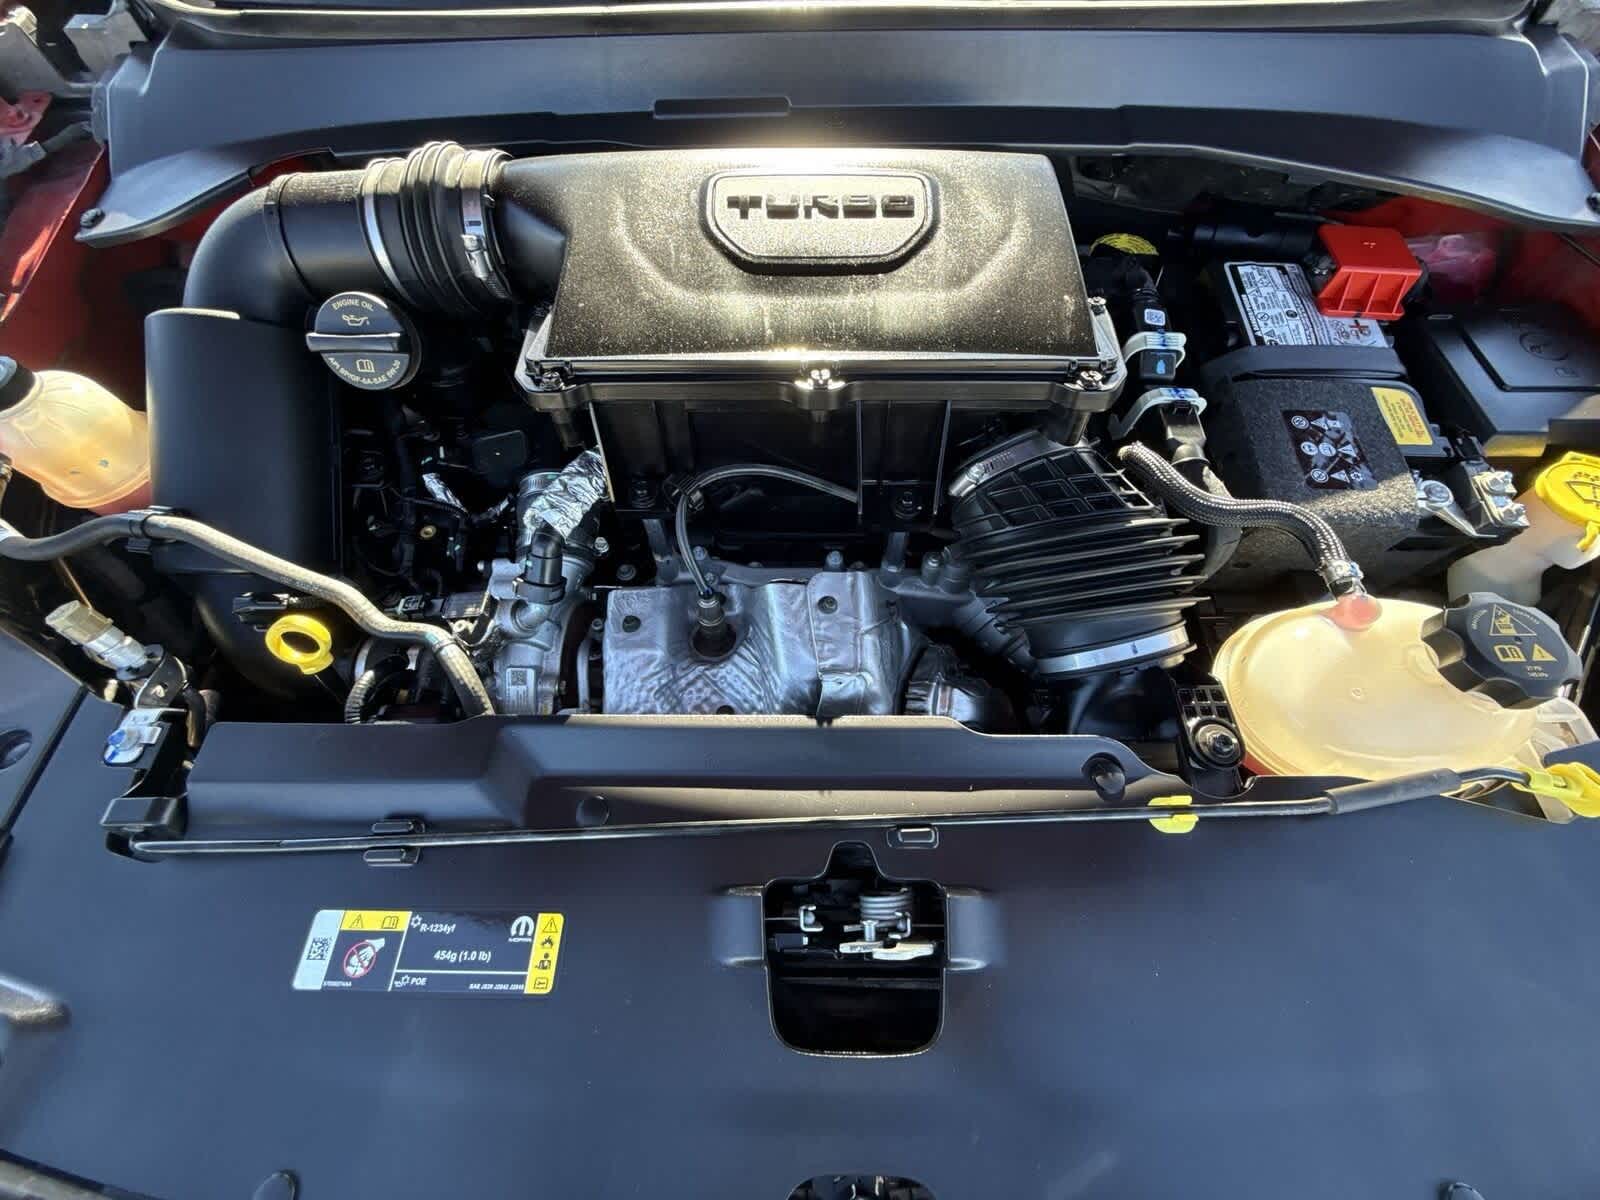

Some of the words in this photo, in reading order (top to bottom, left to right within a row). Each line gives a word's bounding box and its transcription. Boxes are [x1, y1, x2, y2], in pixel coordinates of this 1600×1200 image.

[332, 299, 360, 311] ENGINE
[361, 301, 374, 312] OIL
[420, 923, 456, 934] R-1234yf
[434, 950, 457, 963] 454g
[458, 950, 477, 963] (1.0
[478, 951, 492, 963] lb)
[410, 977, 427, 986] POE
